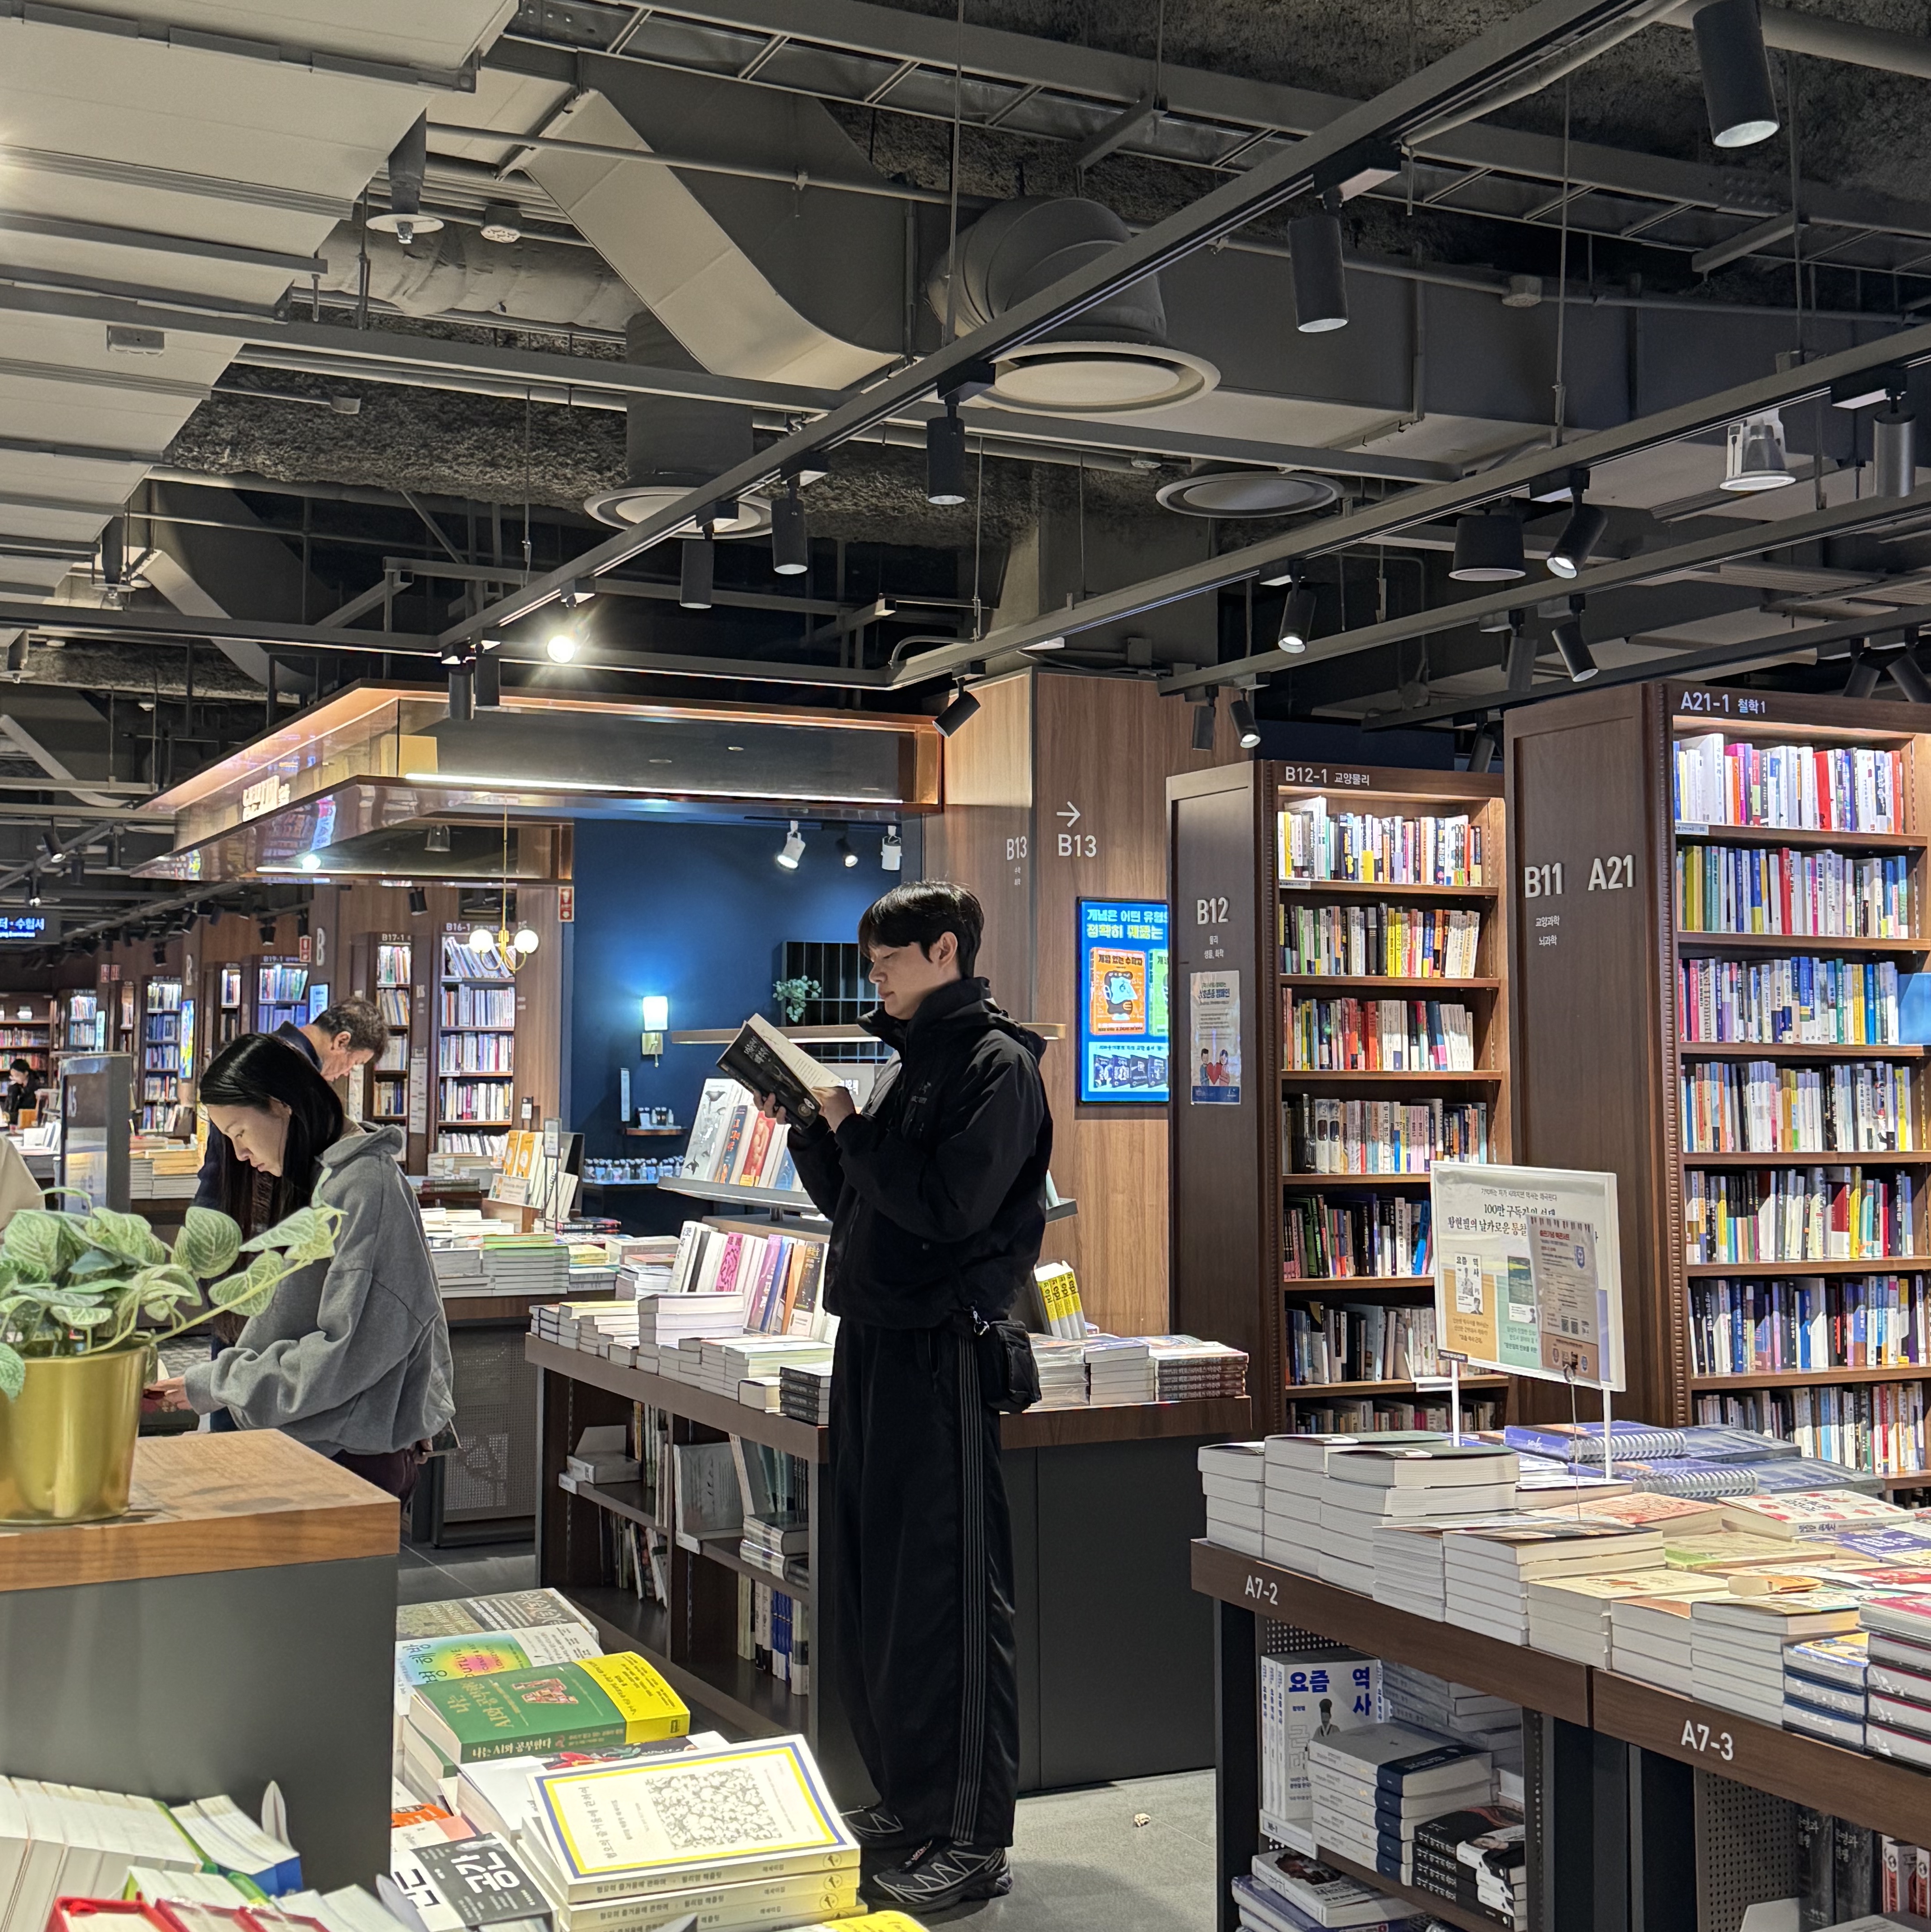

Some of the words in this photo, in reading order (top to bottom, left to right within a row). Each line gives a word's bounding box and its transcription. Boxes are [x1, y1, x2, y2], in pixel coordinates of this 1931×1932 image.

[1680, 691, 1729, 712] A21-1
[1286, 766, 1327, 783] B12-1
[1335, 773, 1369, 786] 교양물리
[1007, 836, 1027, 860] B13
[1058, 834, 1096, 857] B13
[1525, 863, 1562, 898] B11
[1588, 854, 1633, 890] A21
[1197, 897, 1229, 924] B12
[1535, 915, 1559, 927] 교양과학
[446, 923, 470, 932] B16-1
[1539, 935, 1557, 946] 뇌과학
[1484, 1204, 1504, 1217] 100만
[1479, 1219, 1510, 1234] 날카로운
[1245, 1575, 1278, 1606] A7-2
[1289, 1670, 1330, 1693] 요즘
[1353, 1667, 1371, 1716] 역사
[1680, 1720, 1734, 1760] A7-3
